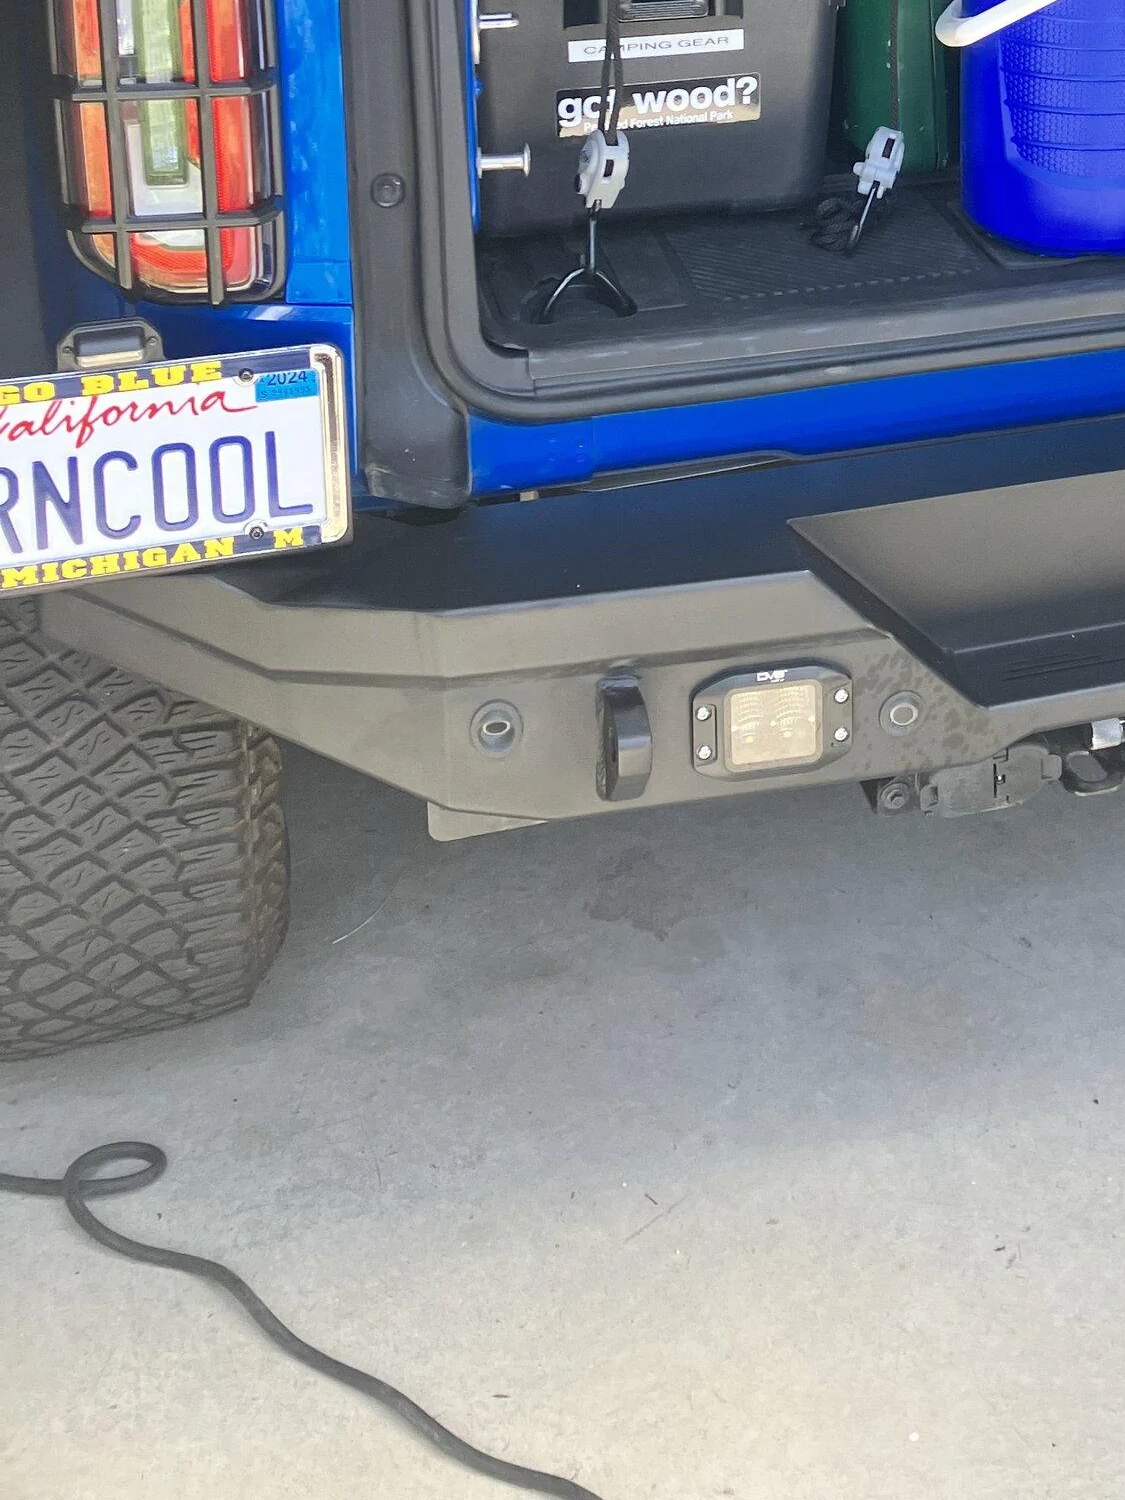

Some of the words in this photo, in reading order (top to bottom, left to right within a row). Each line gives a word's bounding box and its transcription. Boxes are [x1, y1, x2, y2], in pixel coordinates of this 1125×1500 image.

[678, 35, 729, 48] GEAR
[632, 75, 759, 115] wood?
[629, 114, 664, 130] Forest
[665, 111, 708, 126] National
[709, 108, 734, 122] Park
[81, 361, 223, 396] BLUE
[266, 370, 308, 387] 2024
[1, 536, 235, 590] MICHIGAN
[273, 527, 304, 549] M
